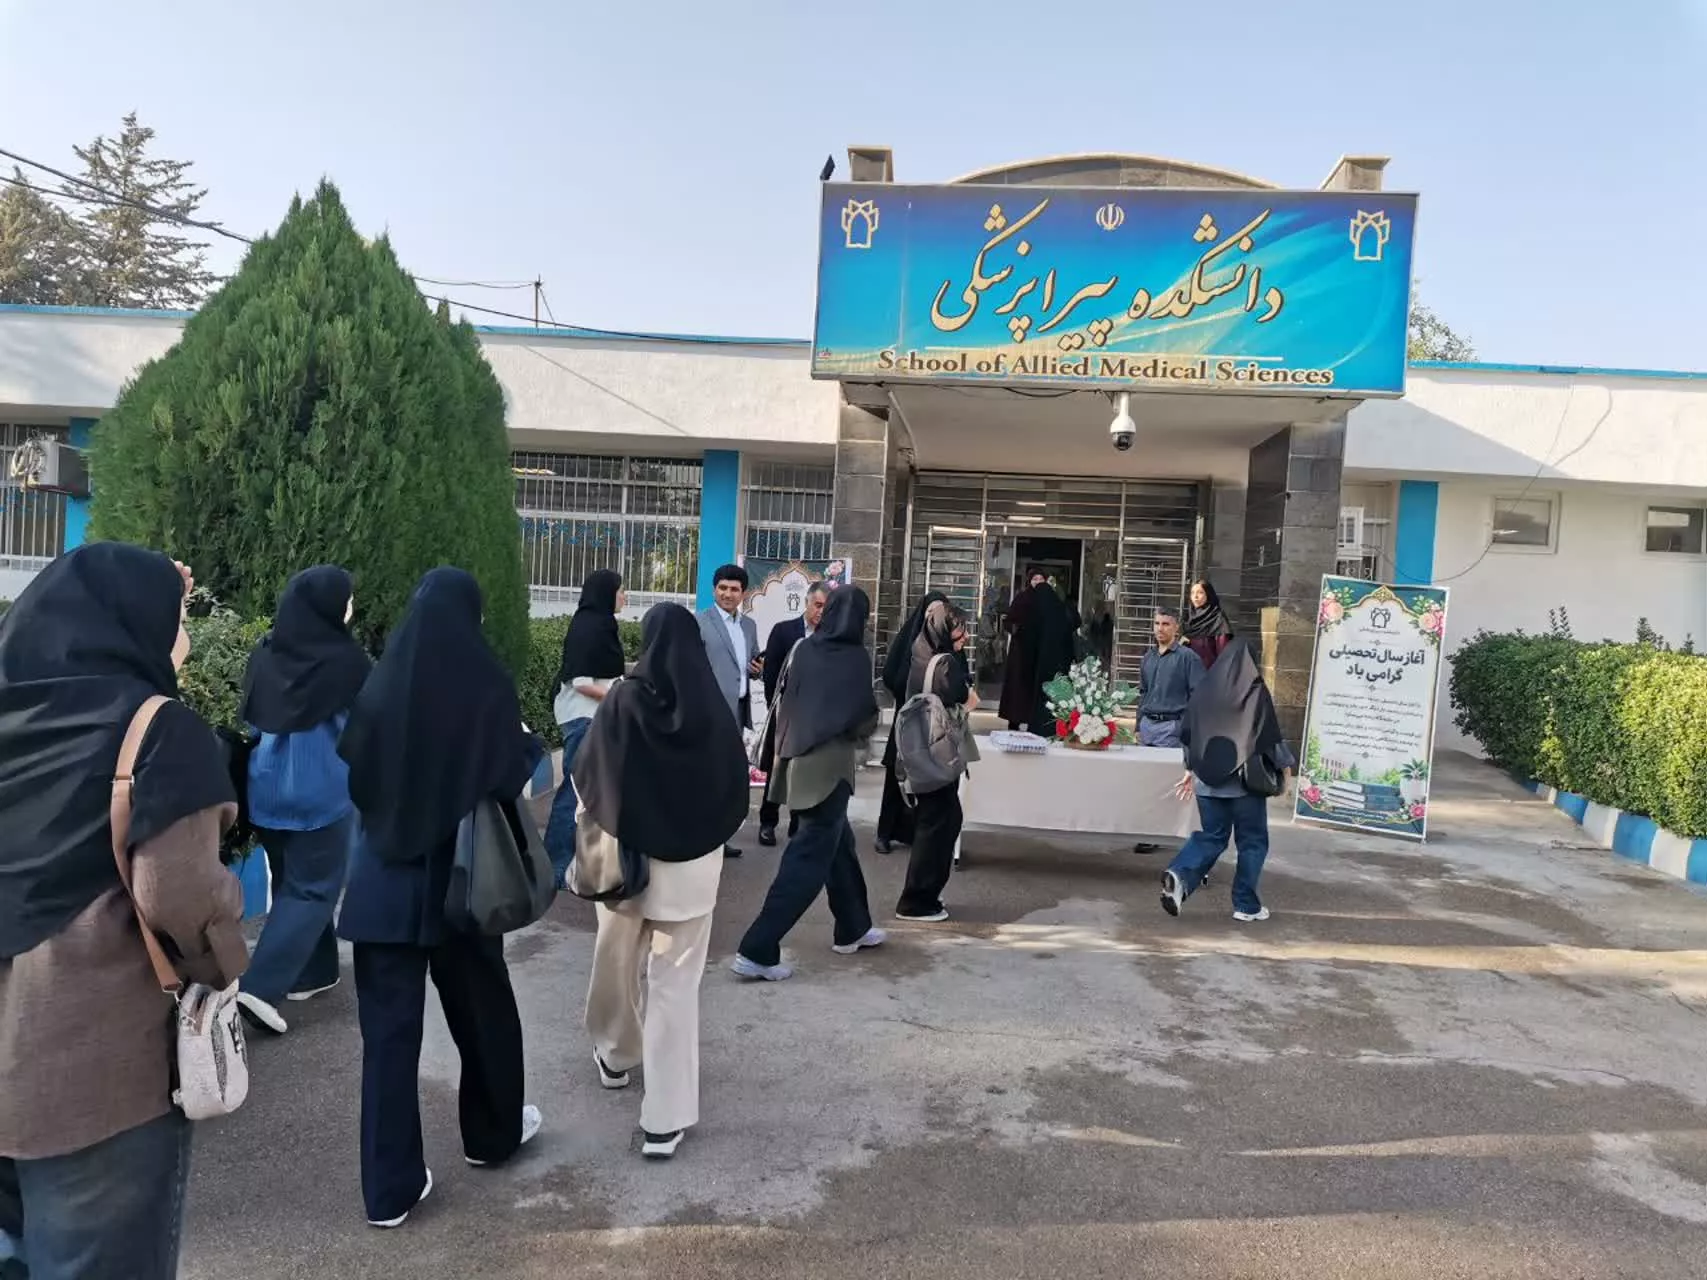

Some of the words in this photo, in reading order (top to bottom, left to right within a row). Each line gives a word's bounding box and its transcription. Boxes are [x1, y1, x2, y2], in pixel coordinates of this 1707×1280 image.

[1128, 208, 1284, 323] دانشکده
[930, 198, 1120, 351] پیراپزشکی
[878, 350, 968, 372] School
[976, 353, 1007, 373] of
[1011, 355, 1089, 376] Allied
[1100, 357, 1207, 380] Medical
[1216, 360, 1333, 384] Sciences
[1329, 644, 1377, 659] تحصیلی
[1377, 648, 1404, 663] سال
[1402, 649, 1425, 666] آغاز
[1346, 663, 1365, 679] باد
[1366, 667, 1404, 684] گرامی
